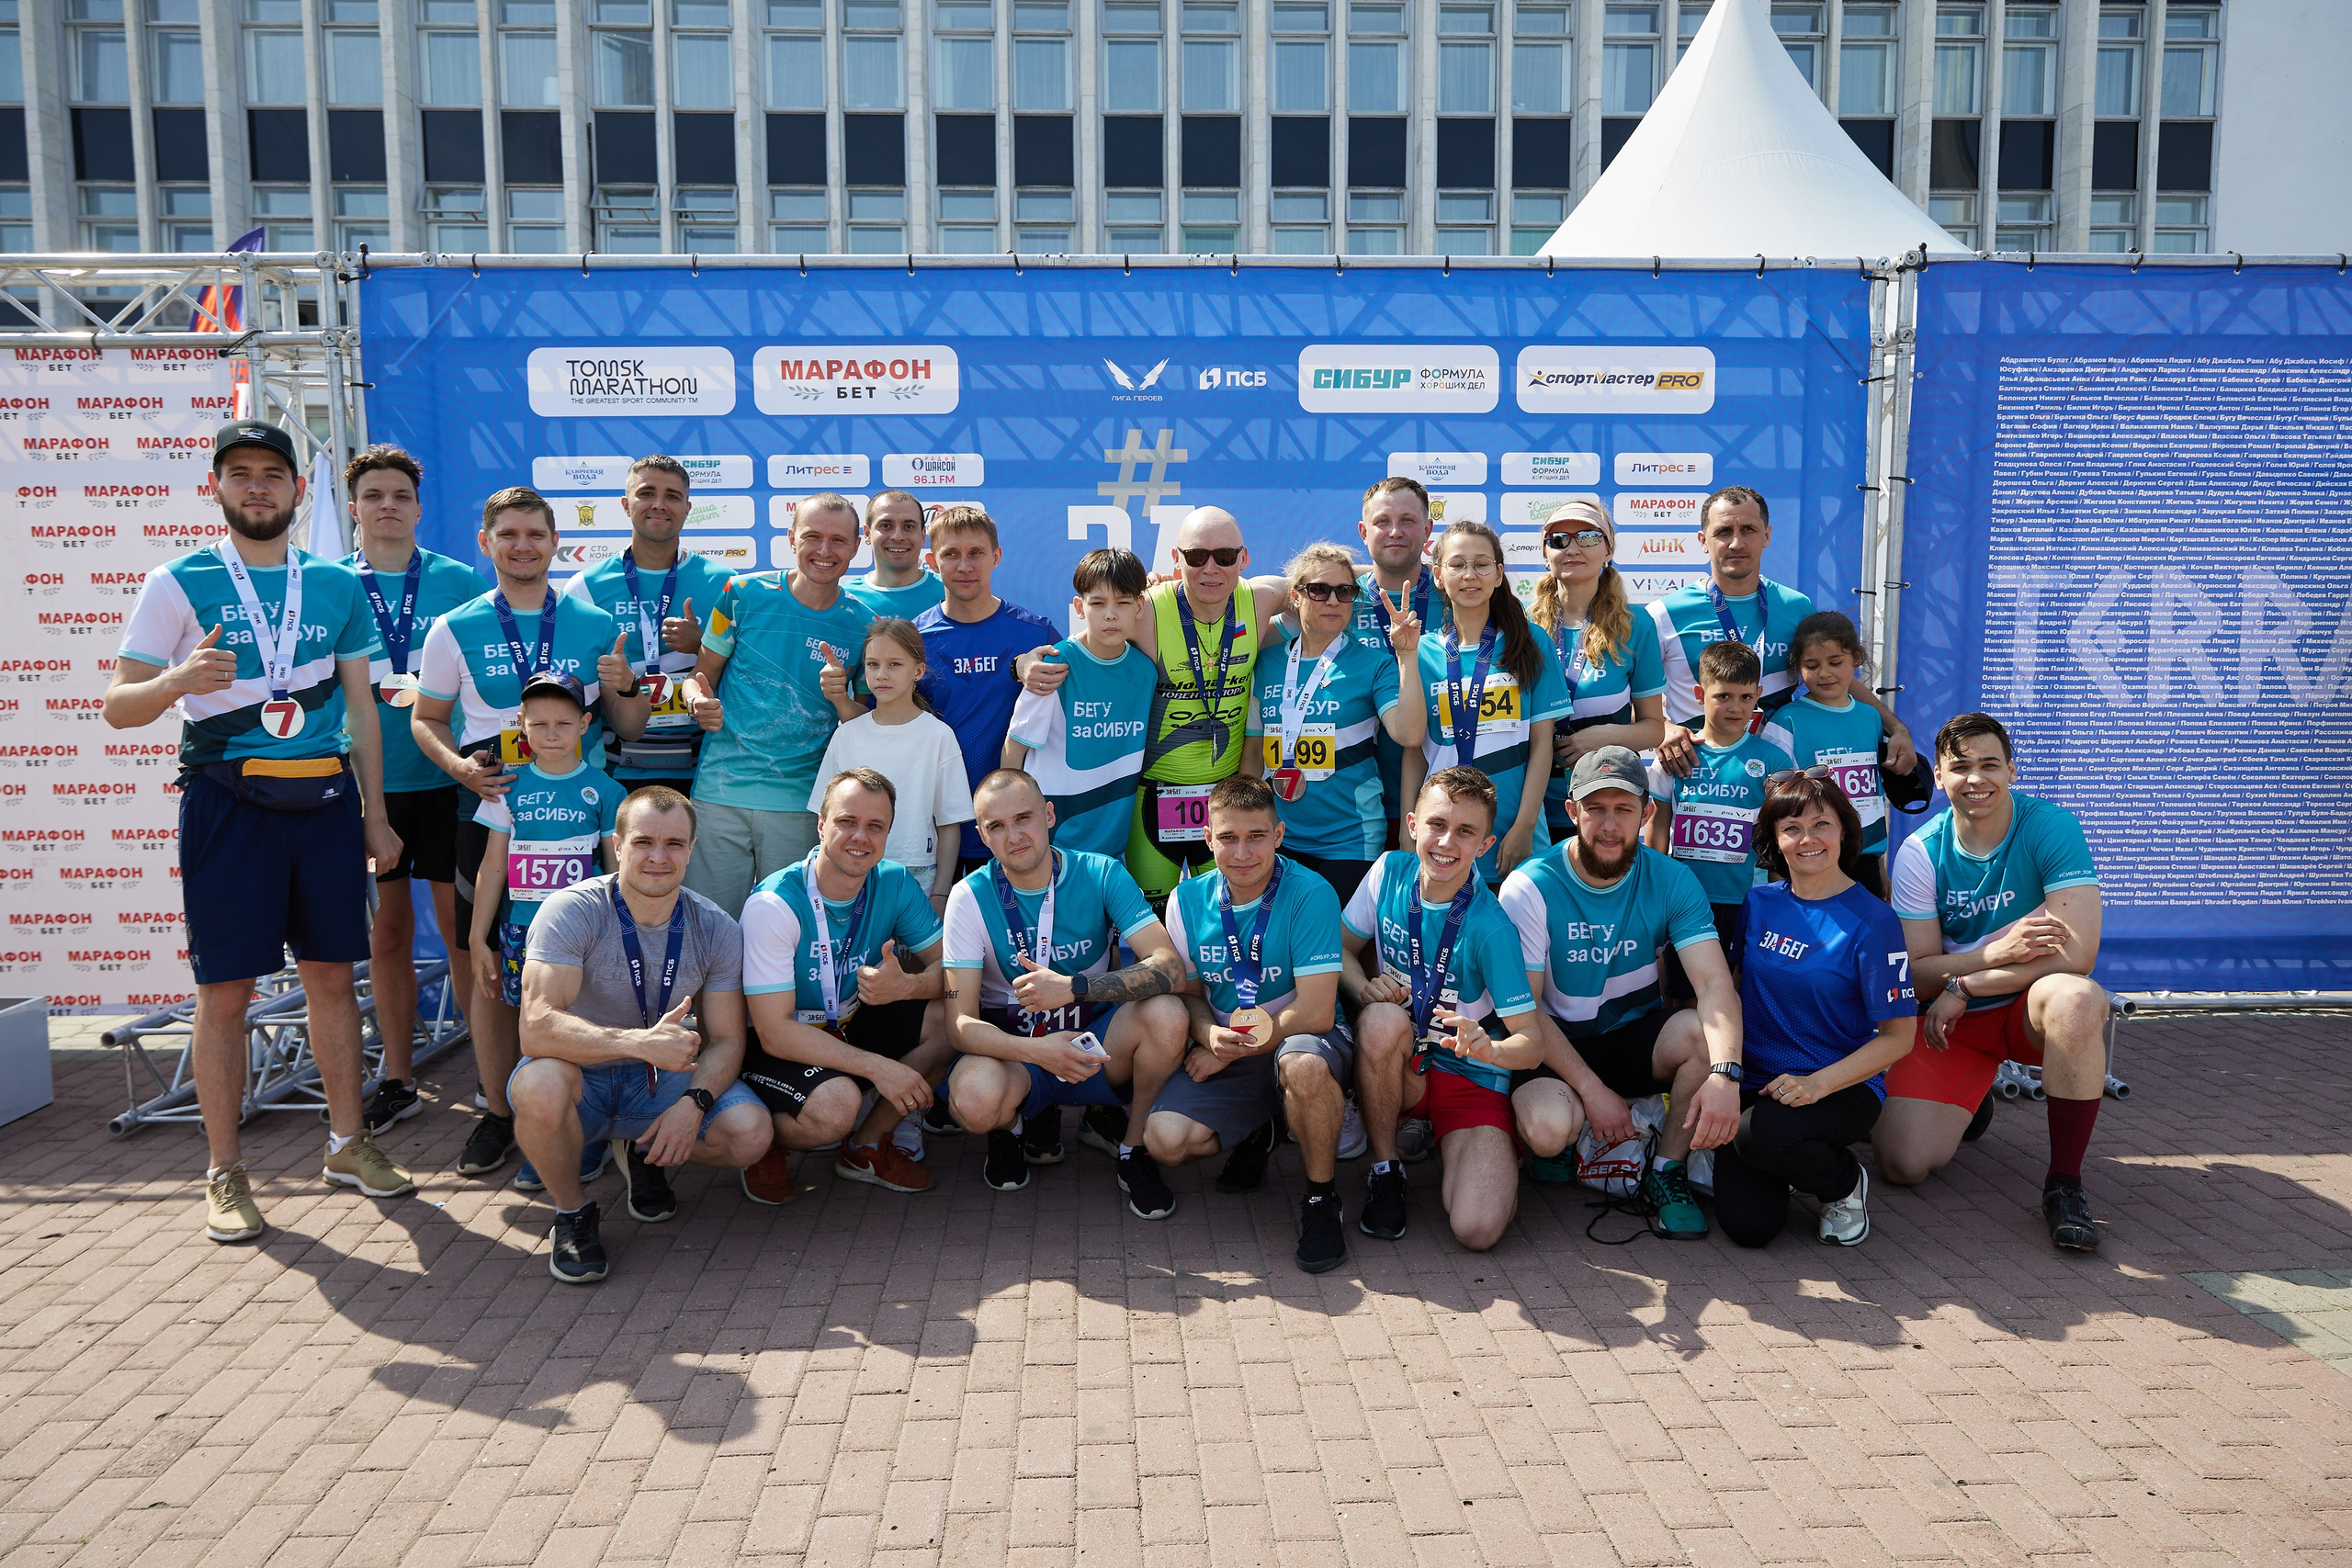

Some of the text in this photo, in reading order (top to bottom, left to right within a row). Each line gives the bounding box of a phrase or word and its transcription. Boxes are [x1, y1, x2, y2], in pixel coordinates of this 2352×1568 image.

[15, 349, 103, 360] МАРАФОН
[130, 349, 218, 360] МАРАФОН
[2197, 356, 2211, 365] Абу
[164, 363, 187, 371] БЕТ
[566, 360, 644, 377] TOMSK
[780, 359, 932, 380] МАРАФОН
[1420, 367, 1485, 380] ФОРМУЛА
[1227, 371, 1267, 387] ПСБ
[1313, 368, 1411, 389] СИБУР
[1420, 380, 1486, 390] ХОРОШИХ ДЕЛ
[1658, 373, 1701, 387] PRO
[571, 378, 697, 395] MARATHON
[837, 387, 876, 399] БЕТ
[77, 398, 163, 409] МАРАФОН
[24, 437, 108, 448] МАРАФОН
[169, 451, 192, 459] БЕТ
[1532, 457, 1569, 465] СИБУР
[682, 460, 721, 468] СИБУР
[786, 465, 840, 476] Литрес
[925, 461, 956, 471] ШАНСОН
[1632, 463, 1684, 474] Литрес
[913, 475, 956, 484] 96.1 FM
[85, 485, 169, 496] МАРАФОН
[1630, 499, 1696, 509] МАРАФОН
[31, 525, 116, 536] МАРАФОН
[143, 525, 228, 536] МАРАФОН
[726, 548, 747, 557] PRO
[404, 593, 413, 606] ПСБ
[374, 600, 385, 614] ПСБ
[39, 613, 122, 624] МАРАФОН
[514, 649, 525, 663] ПСБ
[1471, 683, 1480, 698] ПСБ
[1452, 691, 1460, 705] ПСБ
[1073, 701, 1113, 718] БЕГУ
[264, 702, 298, 736] 7
[1093, 720, 1145, 738] СИБУР
[1270, 739, 1327, 765] 199
[53, 784, 136, 795] МАРАФОН
[1274, 769, 1302, 800] 7
[1698, 783, 1749, 798] СИБУР
[517, 791, 557, 807] БЕГУ
[535, 807, 587, 823] СИБУР
[1175, 800, 1209, 825] 10
[3, 829, 85, 841] МАРАФОН
[1680, 818, 1744, 849] 1635
[61, 867, 142, 879] МАРАФОН
[516, 858, 583, 886] 1579
[9, 914, 91, 925] МАРАФОН
[1567, 921, 1615, 942] БЕГУ
[1016, 931, 1026, 950] ПСБ
[1251, 934, 1261, 950] ПСБ
[69, 951, 150, 961] МАРАФОН
[1231, 943, 1241, 963] ПСБ
[1412, 949, 1420, 965] ПСБ
[1440, 947, 1449, 964] ПСБ
[664, 958, 674, 976] ПСБ
[1887, 951, 1909, 982] 7
[632, 970, 641, 987] ПСБ
